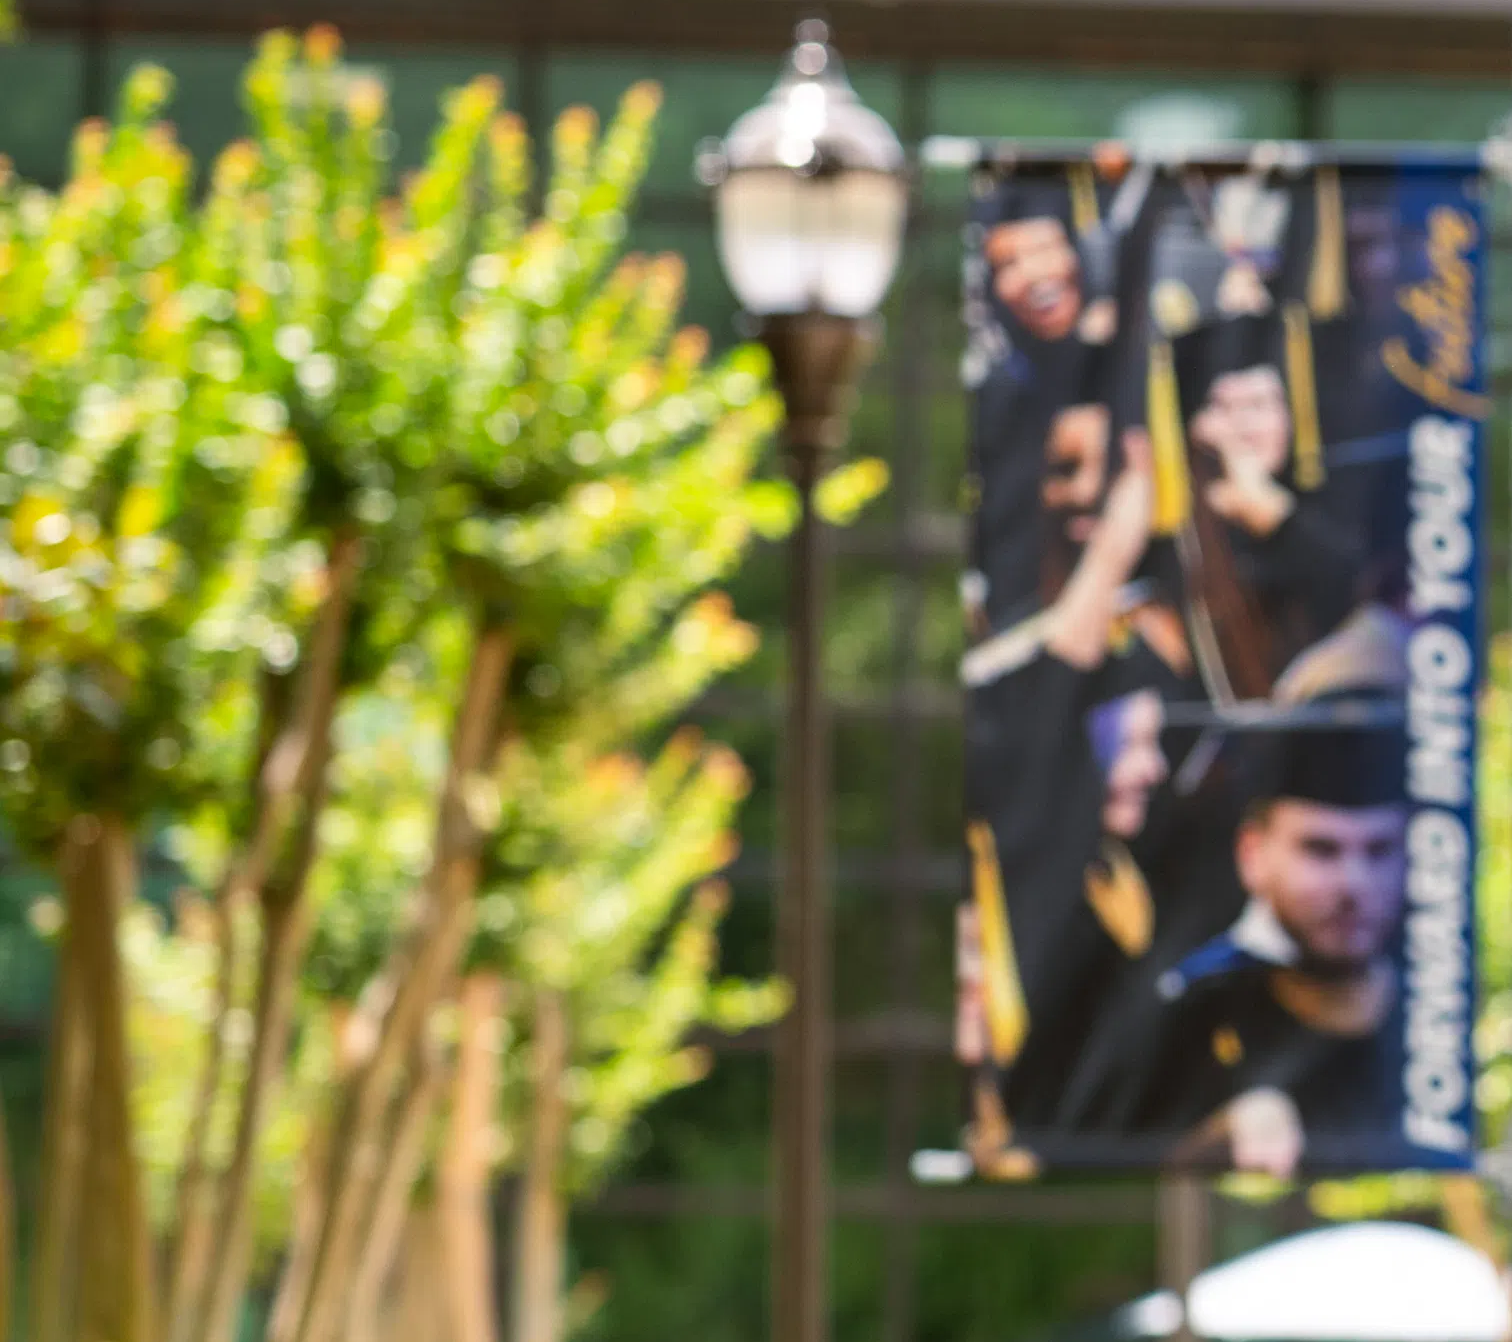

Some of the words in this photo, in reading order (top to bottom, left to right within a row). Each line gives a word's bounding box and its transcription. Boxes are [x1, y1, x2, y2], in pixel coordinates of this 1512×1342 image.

[1380, 205, 1494, 423] future
[1406, 415, 1474, 618] YOUR
[1405, 622, 1473, 805] INTO
[1404, 811, 1470, 1151] FORWARD
